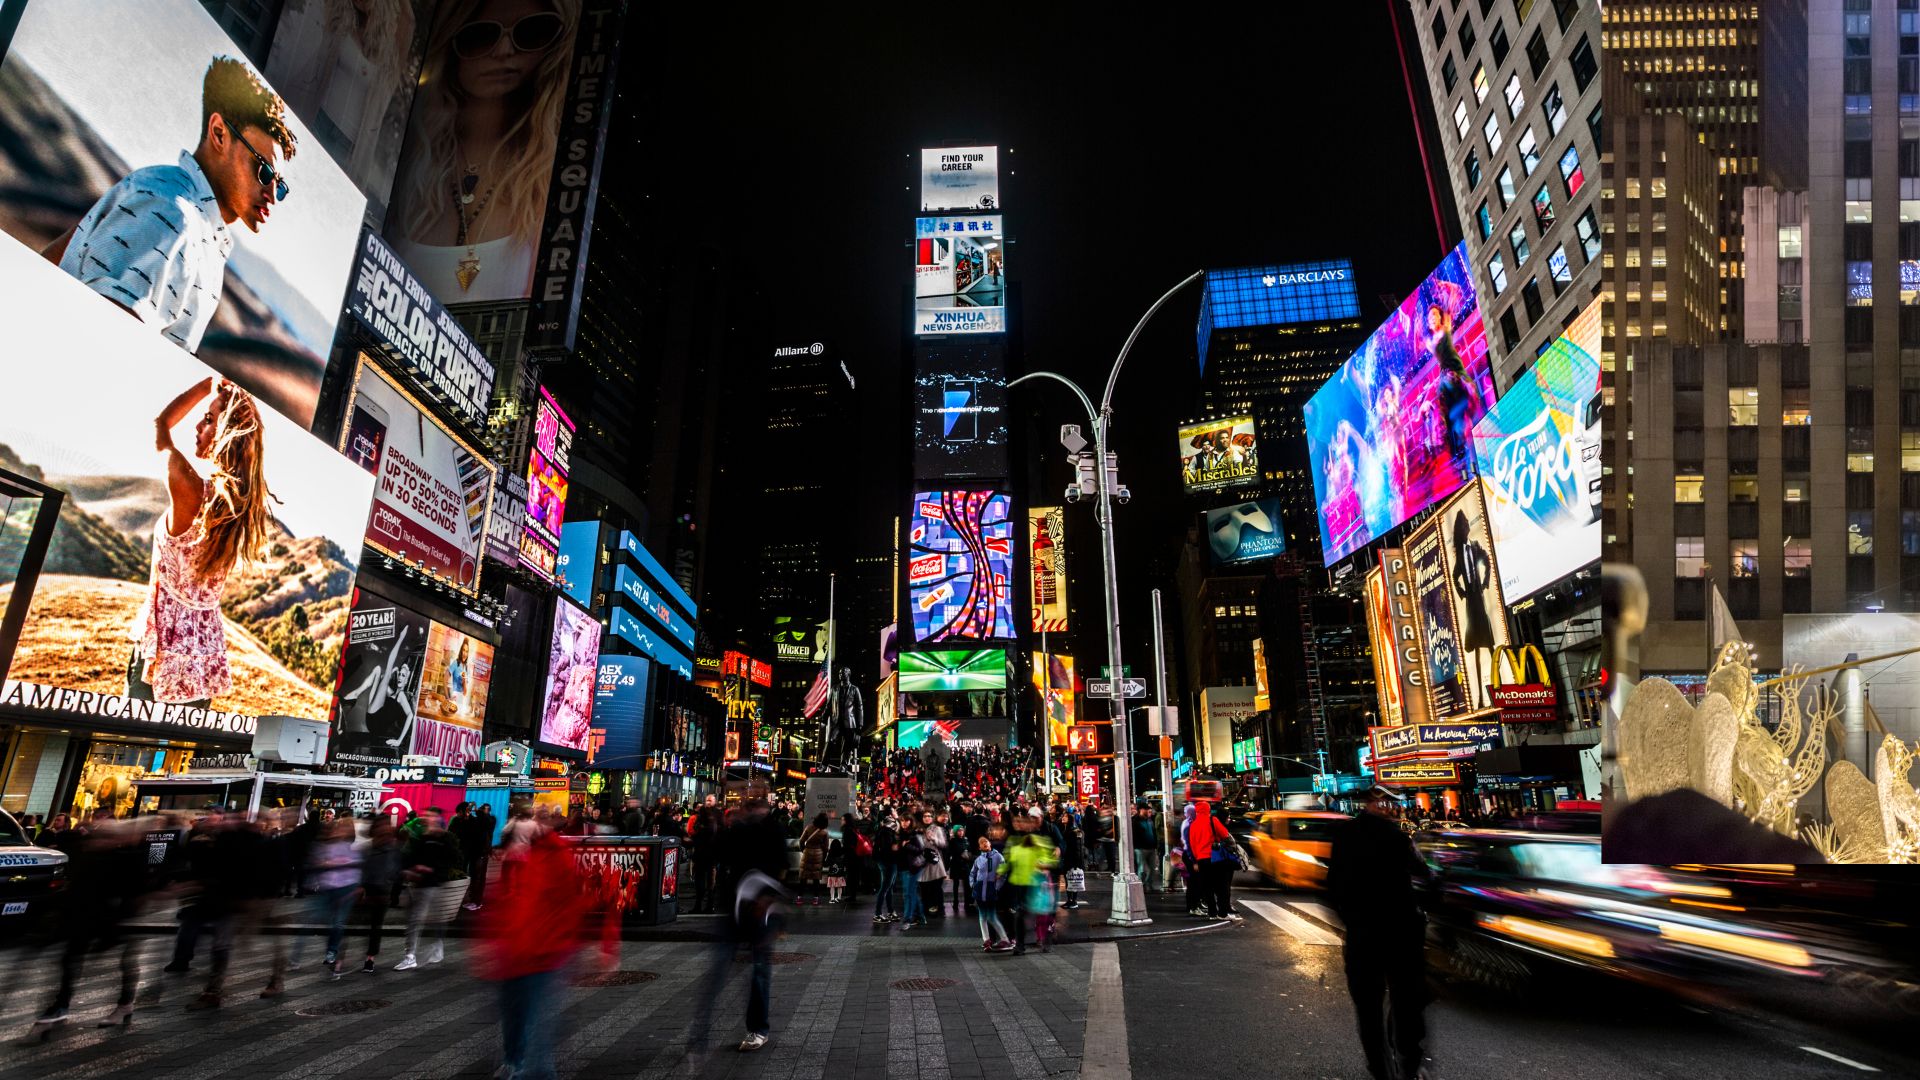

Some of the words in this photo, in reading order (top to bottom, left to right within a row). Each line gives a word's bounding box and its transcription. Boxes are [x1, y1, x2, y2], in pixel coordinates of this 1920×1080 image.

[575, 10, 611, 123] TIMES
[941, 154, 960, 162] FIND
[962, 153, 984, 161] YOUR
[941, 163, 972, 171] CAREER
[543, 139, 587, 301] SQUARE
[356, 257, 378, 301] THE
[1279, 269, 1345, 285] BARCLAYS
[366, 233, 405, 286] CYNTHIA
[405, 273, 432, 313] ERIVO
[436, 312, 469, 350] JENNIFER
[468, 342, 495, 383] HUDSON
[934, 312, 986, 323] XINHUA
[538, 322, 559, 330] NYC
[923, 323, 953, 332] NEWS
[371, 269, 437, 360] COLOR
[434, 330, 492, 415] PURPLE
[374, 318, 420, 367] MIRACLE
[420, 355, 433, 378] ON
[774, 346, 809, 357] Allianz
[982, 406, 1000, 415] edge
[357, 434, 376, 450] TODAY
[1208, 459, 1228, 472] Les
[387, 446, 433, 484] BROADWAY
[434, 479, 462, 505] TICKETS
[385, 459, 401, 478] UP
[403, 470, 417, 491] TO
[418, 483, 440, 507] 50%
[440, 500, 460, 519] OFF
[381, 476, 395, 495] IN
[395, 485, 410, 504] 30
[411, 497, 457, 535] SECONDS
[379, 508, 401, 526] TODAY
[382, 518, 395, 536] TIX
[487, 511, 524, 551] URPLE
[402, 529, 411, 542] The
[411, 534, 431, 557] Broadway
[430, 546, 443, 560] Ticket
[442, 553, 451, 566] App
[1240, 536, 1282, 550] PHANTOM
[556, 554, 570, 566] 49
[911, 560, 942, 577] Coca-Cola
[632, 580, 650, 606] 437.49
[352, 614, 367, 628] 20
[367, 611, 394, 627] YEARS
[1391, 558, 1424, 686] PALACE
[599, 664, 623, 676] AEX
[696, 656, 722, 669] eese's
[598, 674, 635, 686] 437.49
[1092, 684, 1110, 692] ONE
[1495, 690, 1554, 700] McDonald's
[7, 681, 157, 722] AMERICAN
[162, 703, 226, 730] EAGLE
[230, 713, 257, 734] OU
[727, 699, 757, 721] EY'S
[1087, 732, 1095, 749] 9
[1434, 726, 1467, 741] American
[414, 717, 483, 769] WAITRESS
[959, 739, 982, 748] LUXURY
[1482, 742, 1492, 752] ATM
[336, 752, 400, 765] CHICAGOTHEMUSICAL.COM
[390, 768, 425, 781] NYC
[1082, 767, 1096, 794] tkts
